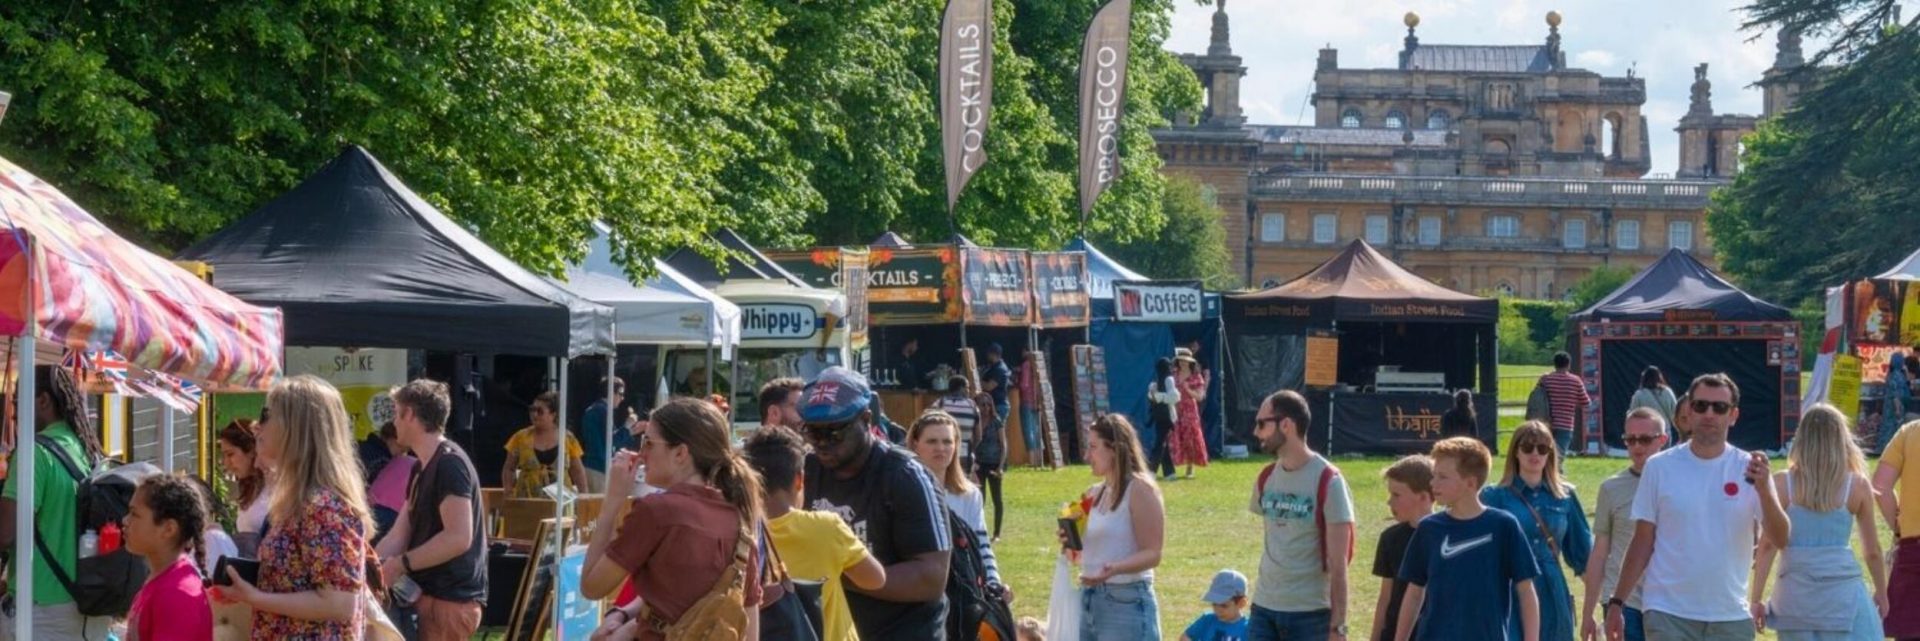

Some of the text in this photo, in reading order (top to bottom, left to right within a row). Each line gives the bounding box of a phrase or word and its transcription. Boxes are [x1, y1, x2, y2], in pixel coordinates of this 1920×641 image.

[958, 23, 982, 173] COCKTAILS
[1096, 46, 1117, 183] PROSECCO
[831, 270, 919, 286] CKTAILS
[1370, 303, 1464, 316] Indian Street Food
[334, 355, 374, 371] SPKE
[1385, 406, 1442, 439] bhajis
